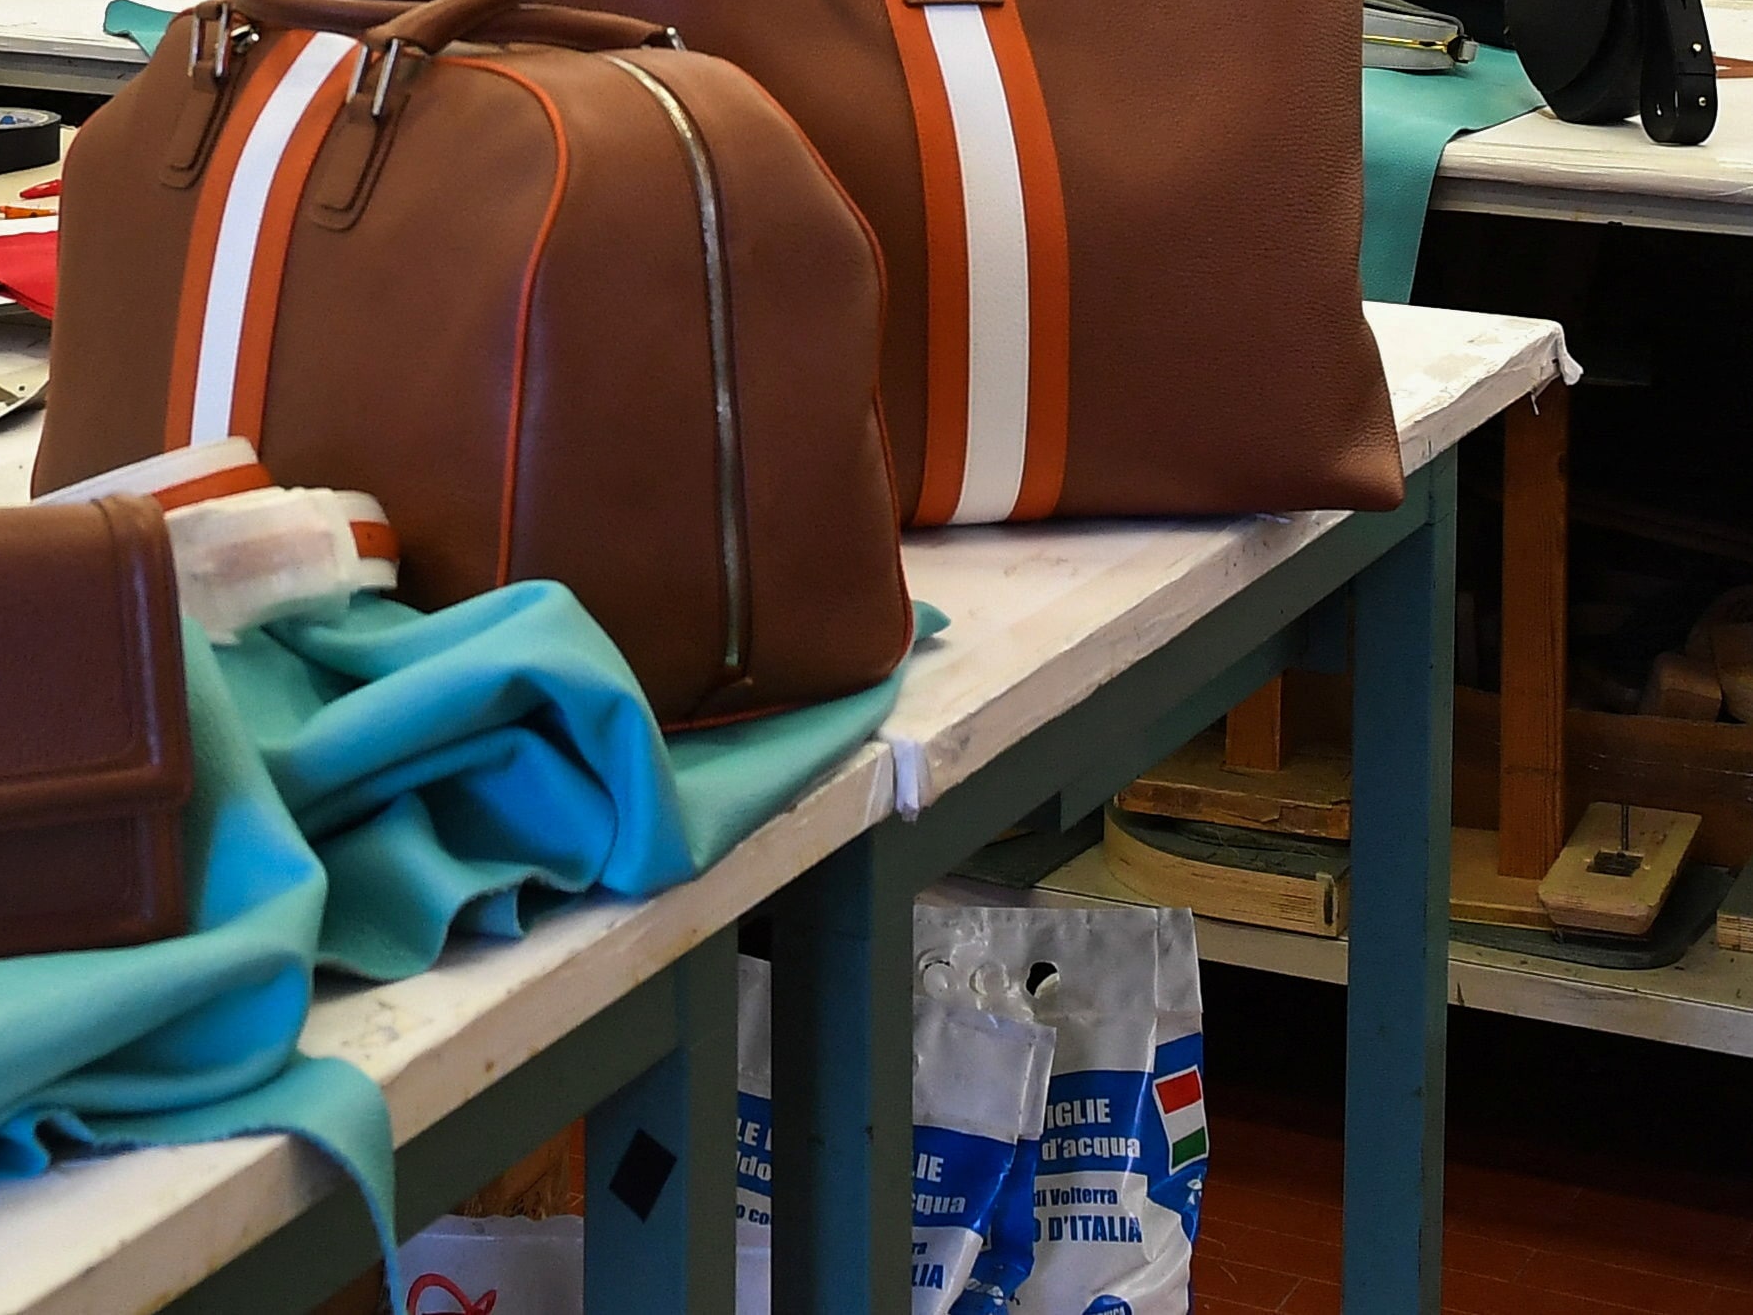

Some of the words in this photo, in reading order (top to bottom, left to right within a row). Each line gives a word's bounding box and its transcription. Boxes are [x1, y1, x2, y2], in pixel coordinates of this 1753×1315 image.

[1041, 1136, 1141, 1162] d'acqua
[912, 1191, 966, 1216] qua
[1050, 1187, 1118, 1206] Volterra
[1048, 1215, 1143, 1243] D'ITALIA
